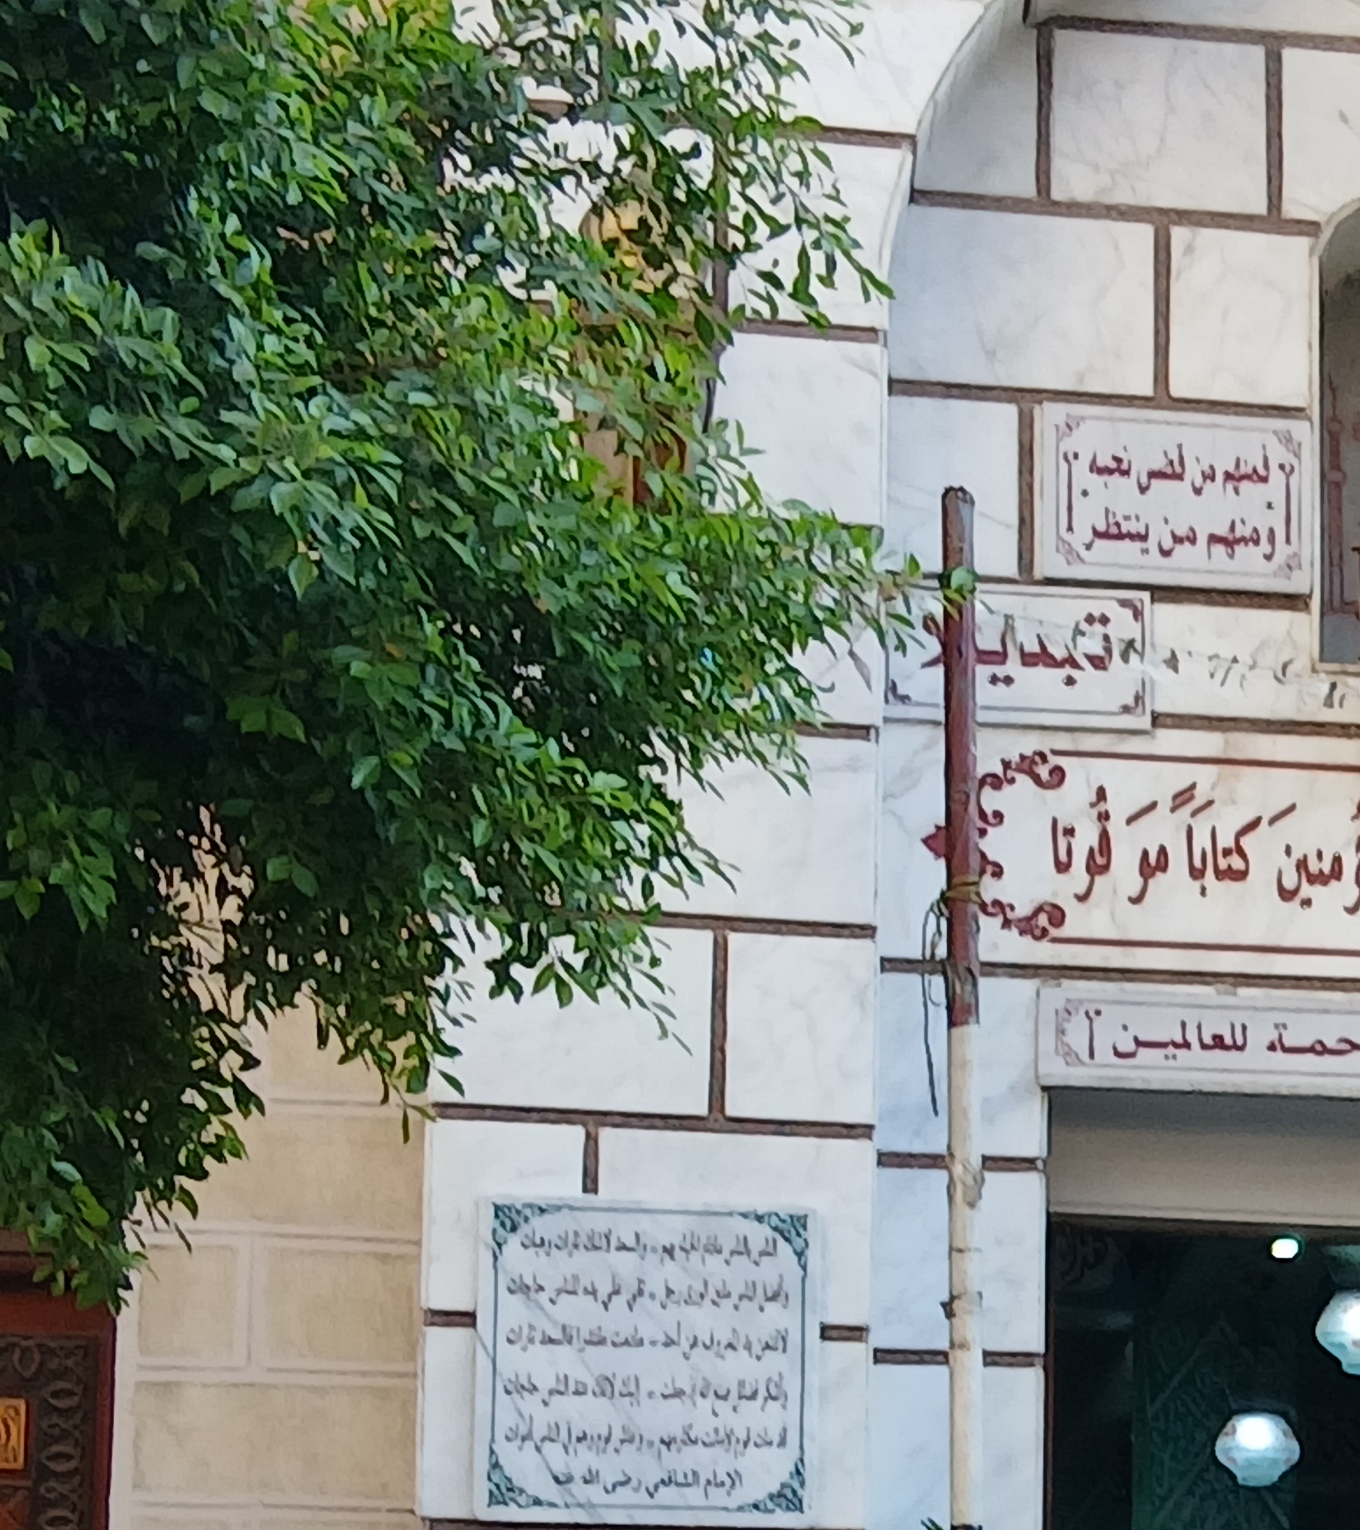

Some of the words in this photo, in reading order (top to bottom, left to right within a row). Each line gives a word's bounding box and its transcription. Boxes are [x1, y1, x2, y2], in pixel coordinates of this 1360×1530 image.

[1191, 456, 1216, 496] من
[1082, 506, 1150, 556] ينتظر
[1158, 516, 1198, 558] من
[1207, 517, 1276, 563] ومنهم
[1112, 1018, 1248, 1062] للعالمين
